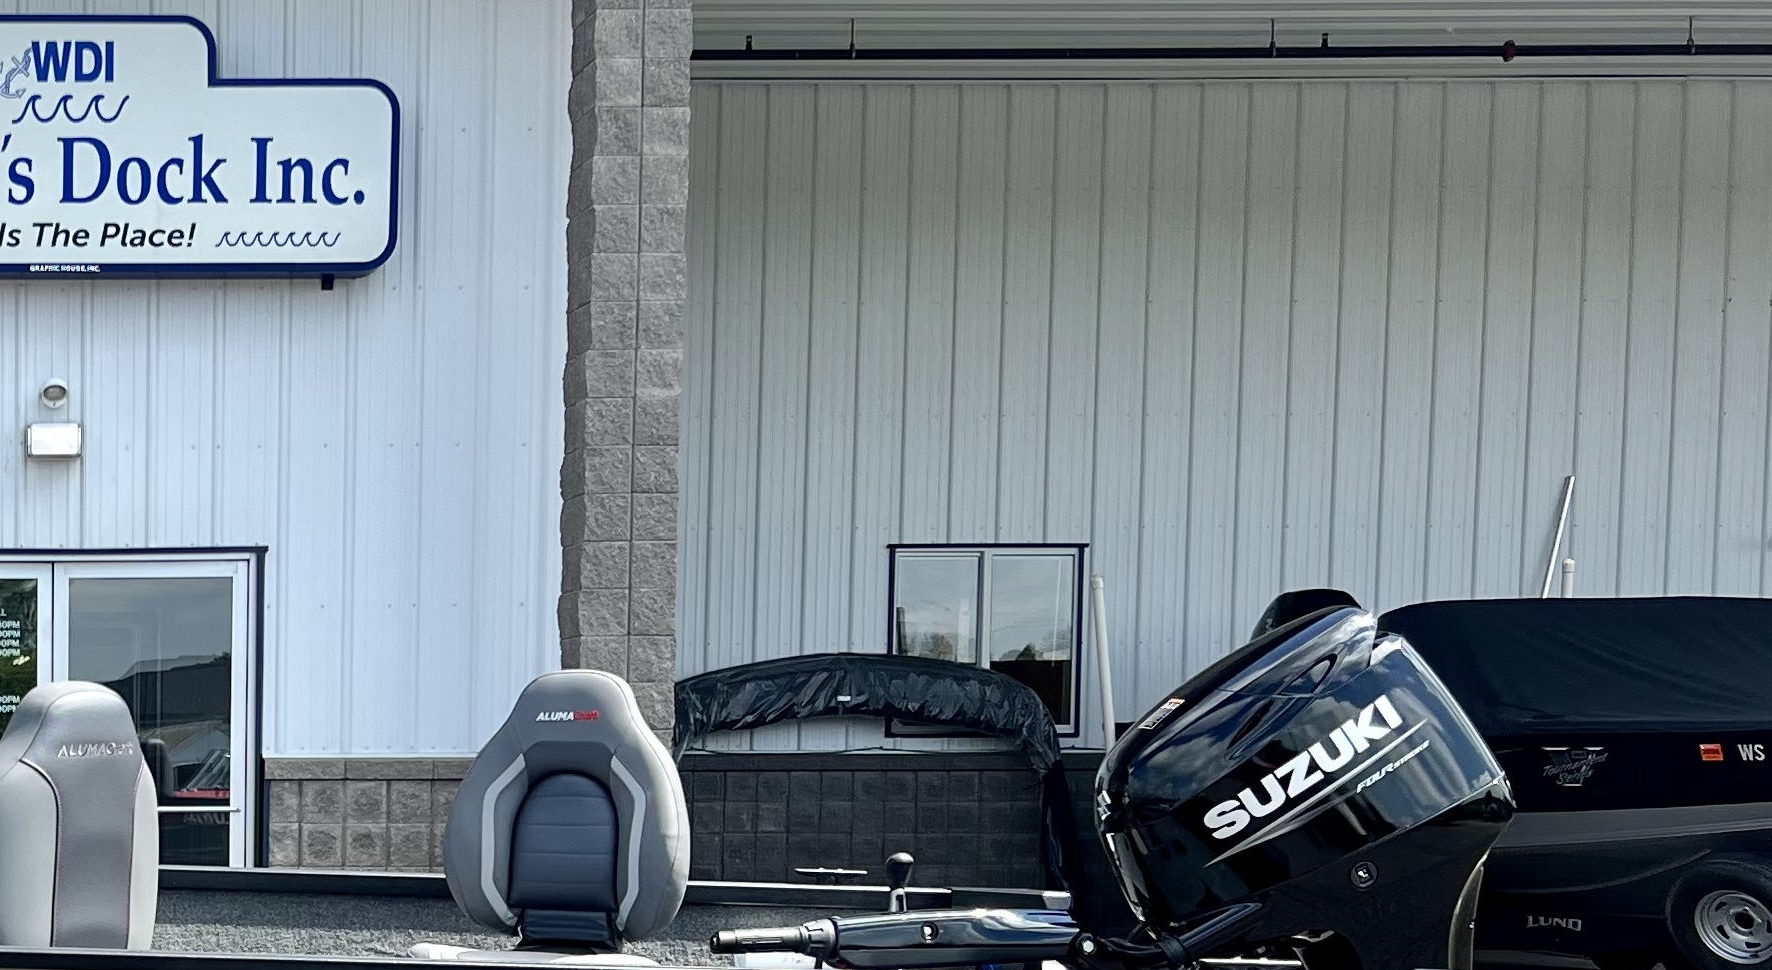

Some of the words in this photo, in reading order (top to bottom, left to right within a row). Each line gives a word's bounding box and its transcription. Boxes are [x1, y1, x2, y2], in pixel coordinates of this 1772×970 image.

[32, 41, 115, 83] WDI
[57, 134, 229, 205] Dock
[250, 137, 365, 206] Inc.
[32, 222, 90, 248] The
[99, 222, 197, 248] Place!
[1203, 694, 1403, 840] SUZUKI
[1737, 744, 1766, 761] WS
[1526, 915, 1582, 931] LUND
